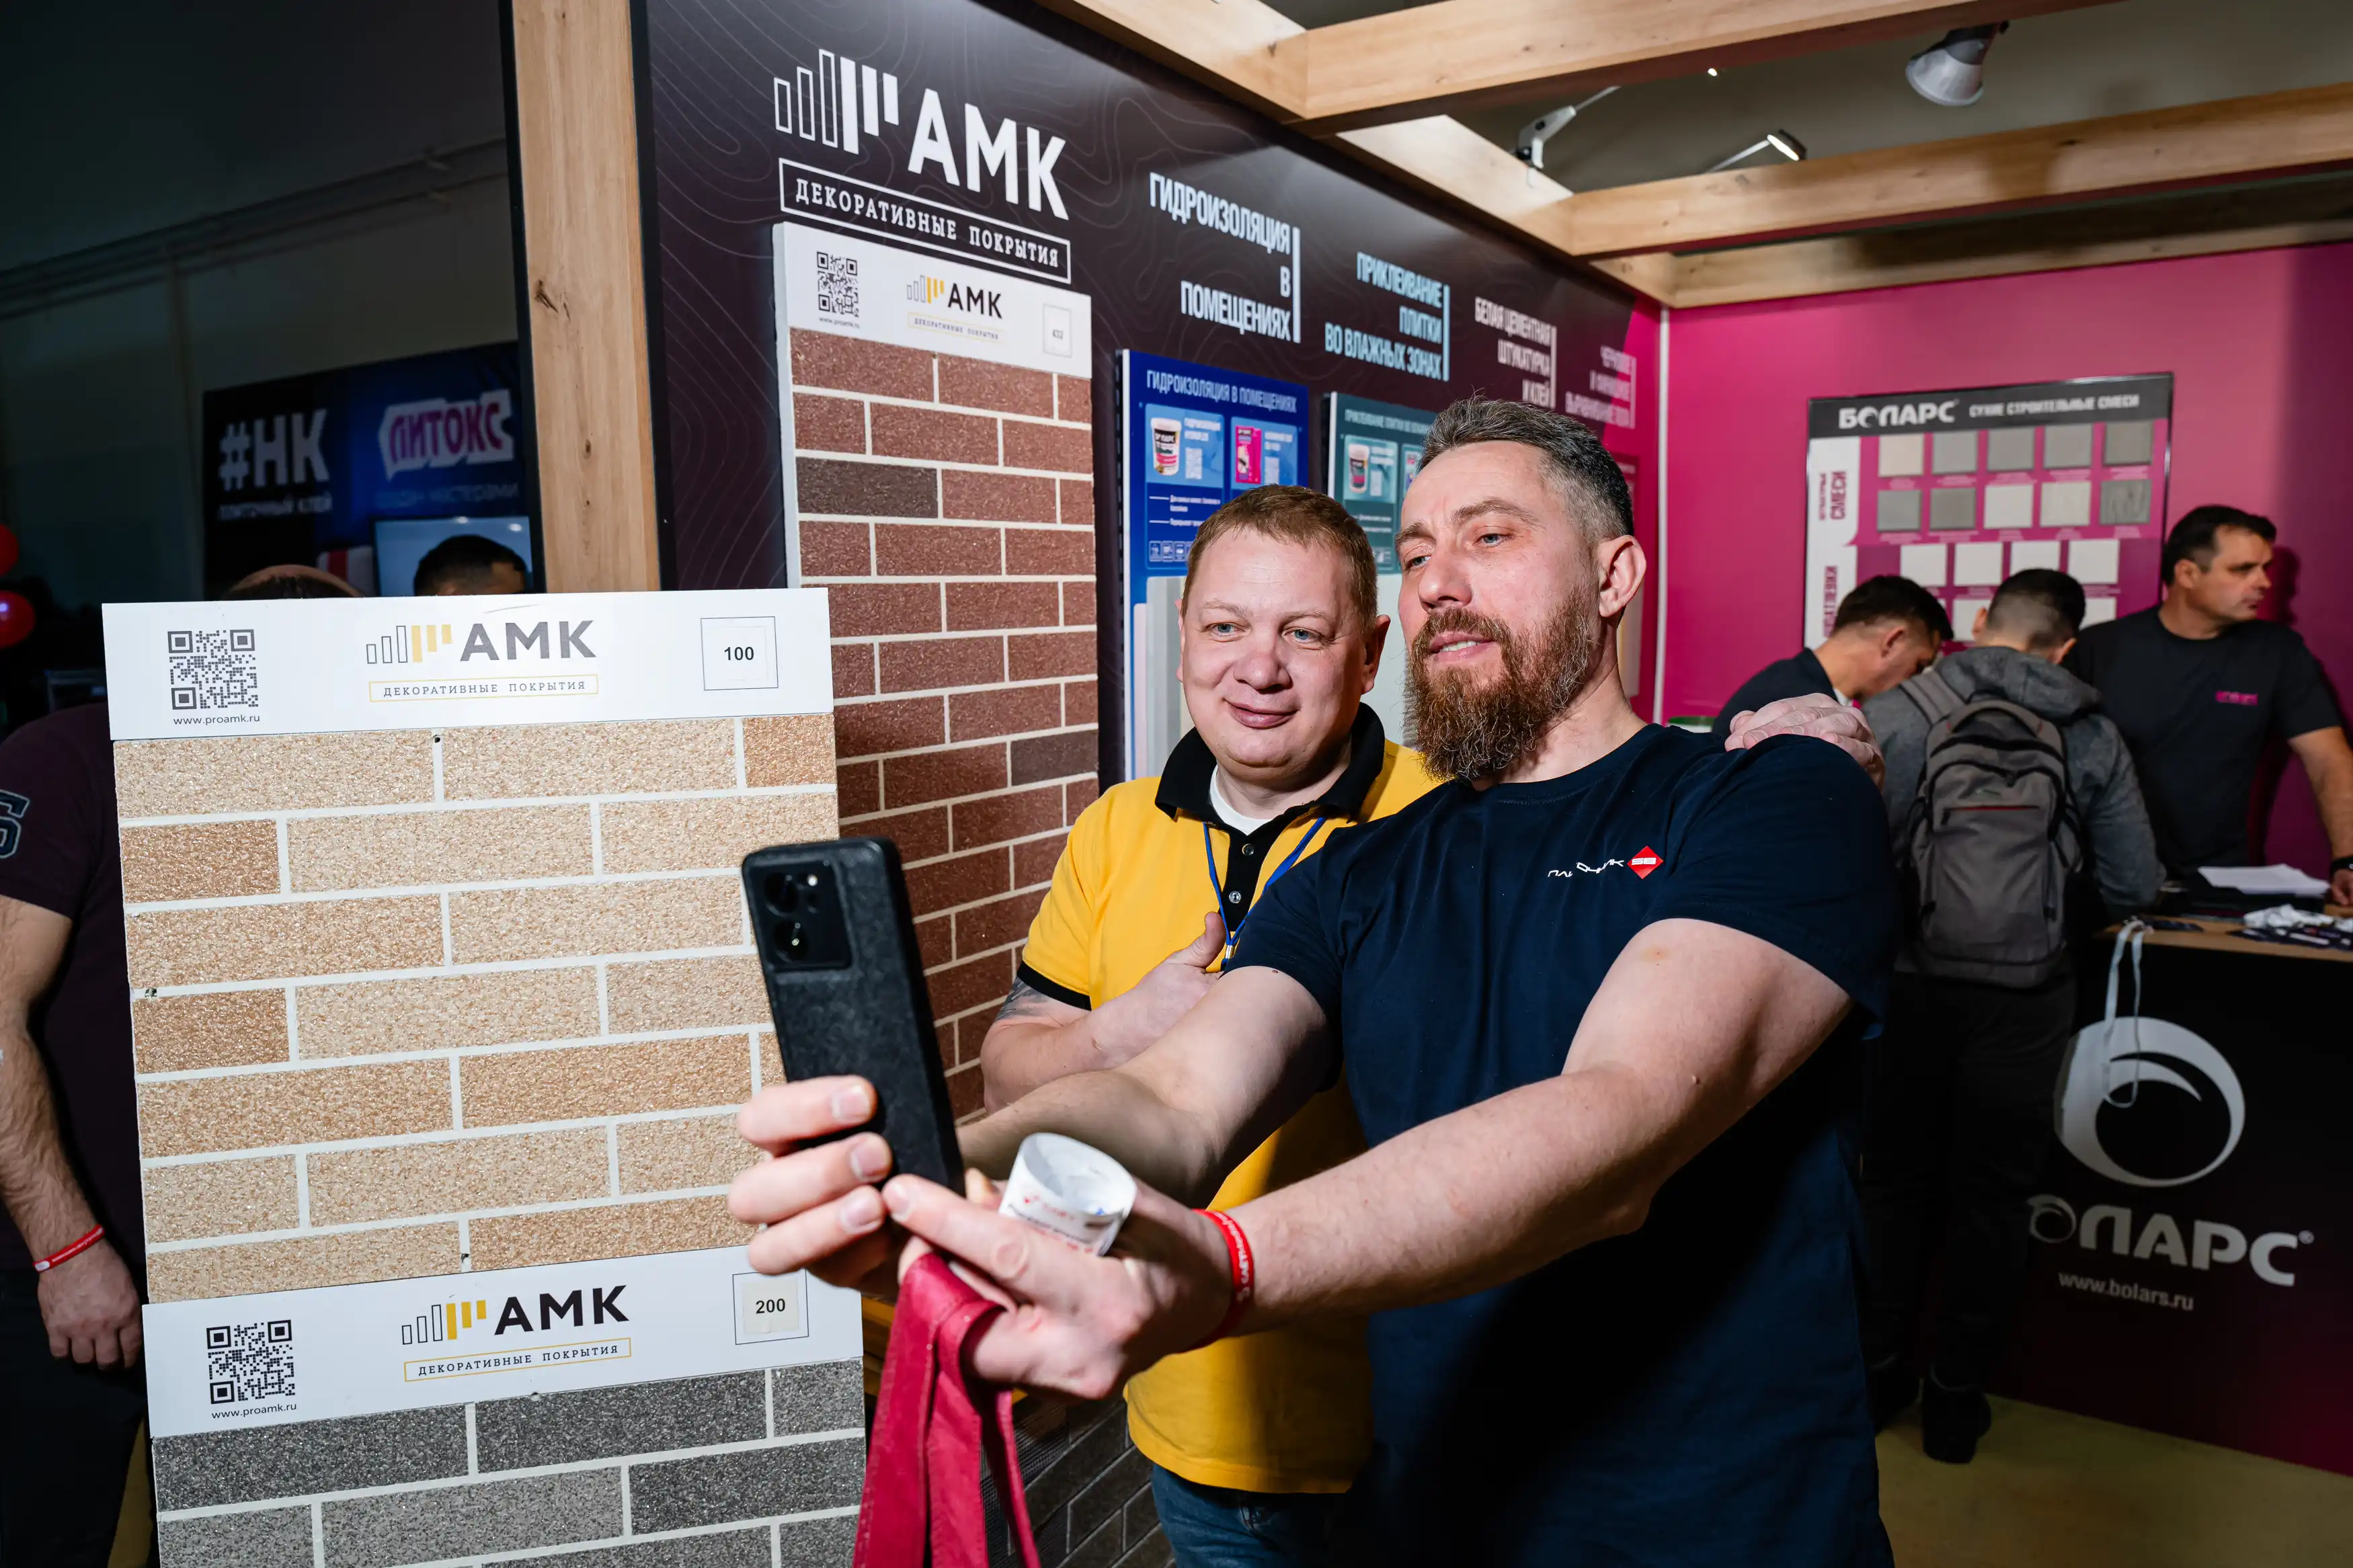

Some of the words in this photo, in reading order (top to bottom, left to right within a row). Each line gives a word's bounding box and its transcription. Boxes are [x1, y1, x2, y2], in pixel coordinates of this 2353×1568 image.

[908, 87, 1069, 220] АМК
[795, 178, 957, 241] ДЕКОРАТИВНЫЕ
[969, 225, 1059, 268] ПОКРЫТИЯ
[1150, 172, 1290, 255] ГИДРОИЗОЛЯЦИЯ
[1280, 265, 1291, 297] В
[1357, 251, 1443, 308] ПРИКЛЕИВАНИЕ
[947, 283, 1002, 319] АМК
[1181, 280, 1291, 341] ПОМЕЩЕНИЯХ
[1475, 296, 1503, 329] БЕЛАЯ
[1399, 306, 1442, 344] ПЛИТКИ
[1324, 322, 1343, 354] ВО
[1344, 327, 1406, 371] ВЛАЖНЫХ
[1406, 346, 1442, 380] ЗОНАХ
[1147, 370, 1230, 403] ГИДРОИЗОЛЯЦИЯ
[1231, 388, 1238, 401] В
[1838, 401, 1956, 429] БОЛАРС
[218, 409, 329, 491] #НК
[461, 620, 596, 662] АМК
[724, 646, 754, 661] 100
[383, 684, 498, 698] ДЕКОРАТИВНЫЕ
[508, 680, 585, 694] ПОКРЫТИЯ
[173, 714, 260, 727] www.proamk.ru
[494, 1284, 630, 1335] АМК
[756, 1298, 786, 1315] 200
[2057, 1271, 2194, 1311] www.bolars.ru
[417, 1353, 532, 1377] ДЕКОРАТИВНЫЕ
[542, 1344, 618, 1363] ПОКРЫТИЯ
[210, 1402, 296, 1420] www.proamk.ru
